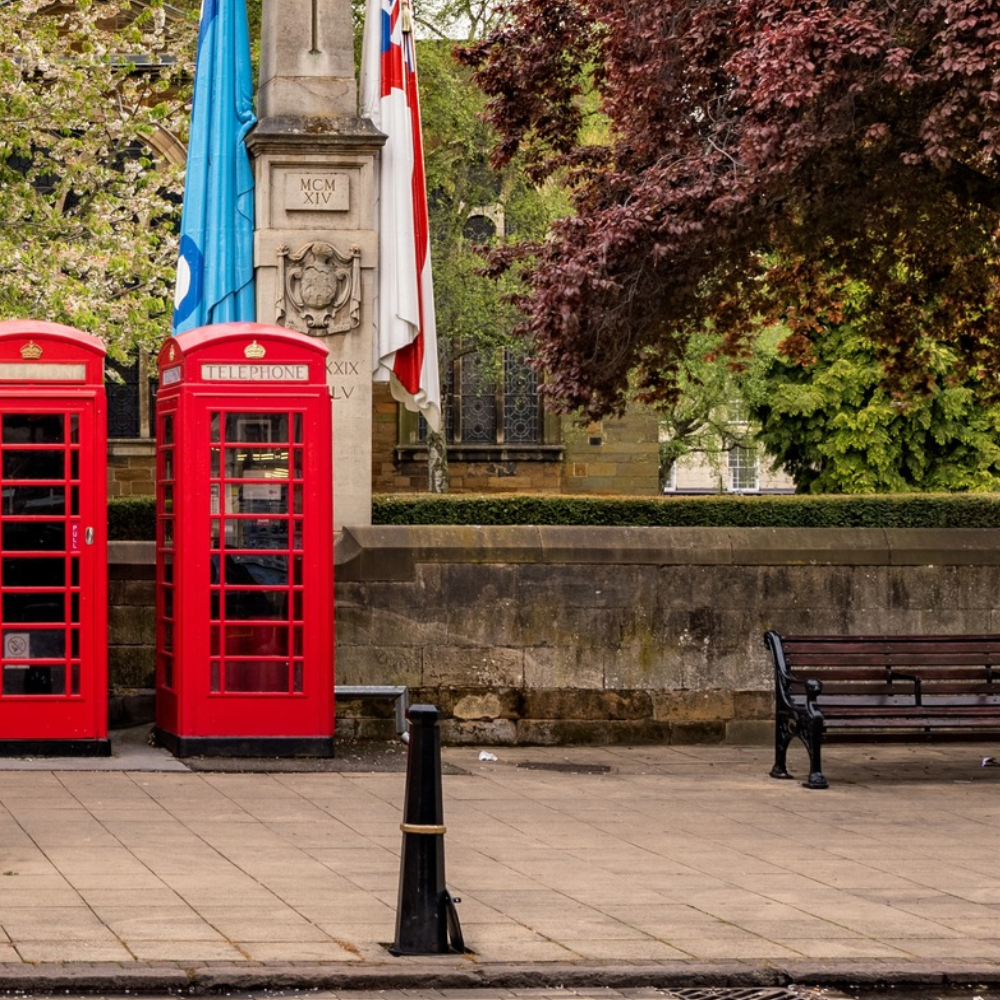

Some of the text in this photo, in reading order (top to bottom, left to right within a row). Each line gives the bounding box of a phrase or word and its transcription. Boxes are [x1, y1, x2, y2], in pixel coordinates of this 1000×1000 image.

[300, 178, 336, 192] MCM
[303, 192, 332, 205] XIV
[206, 365, 305, 380] TELEPHONE
